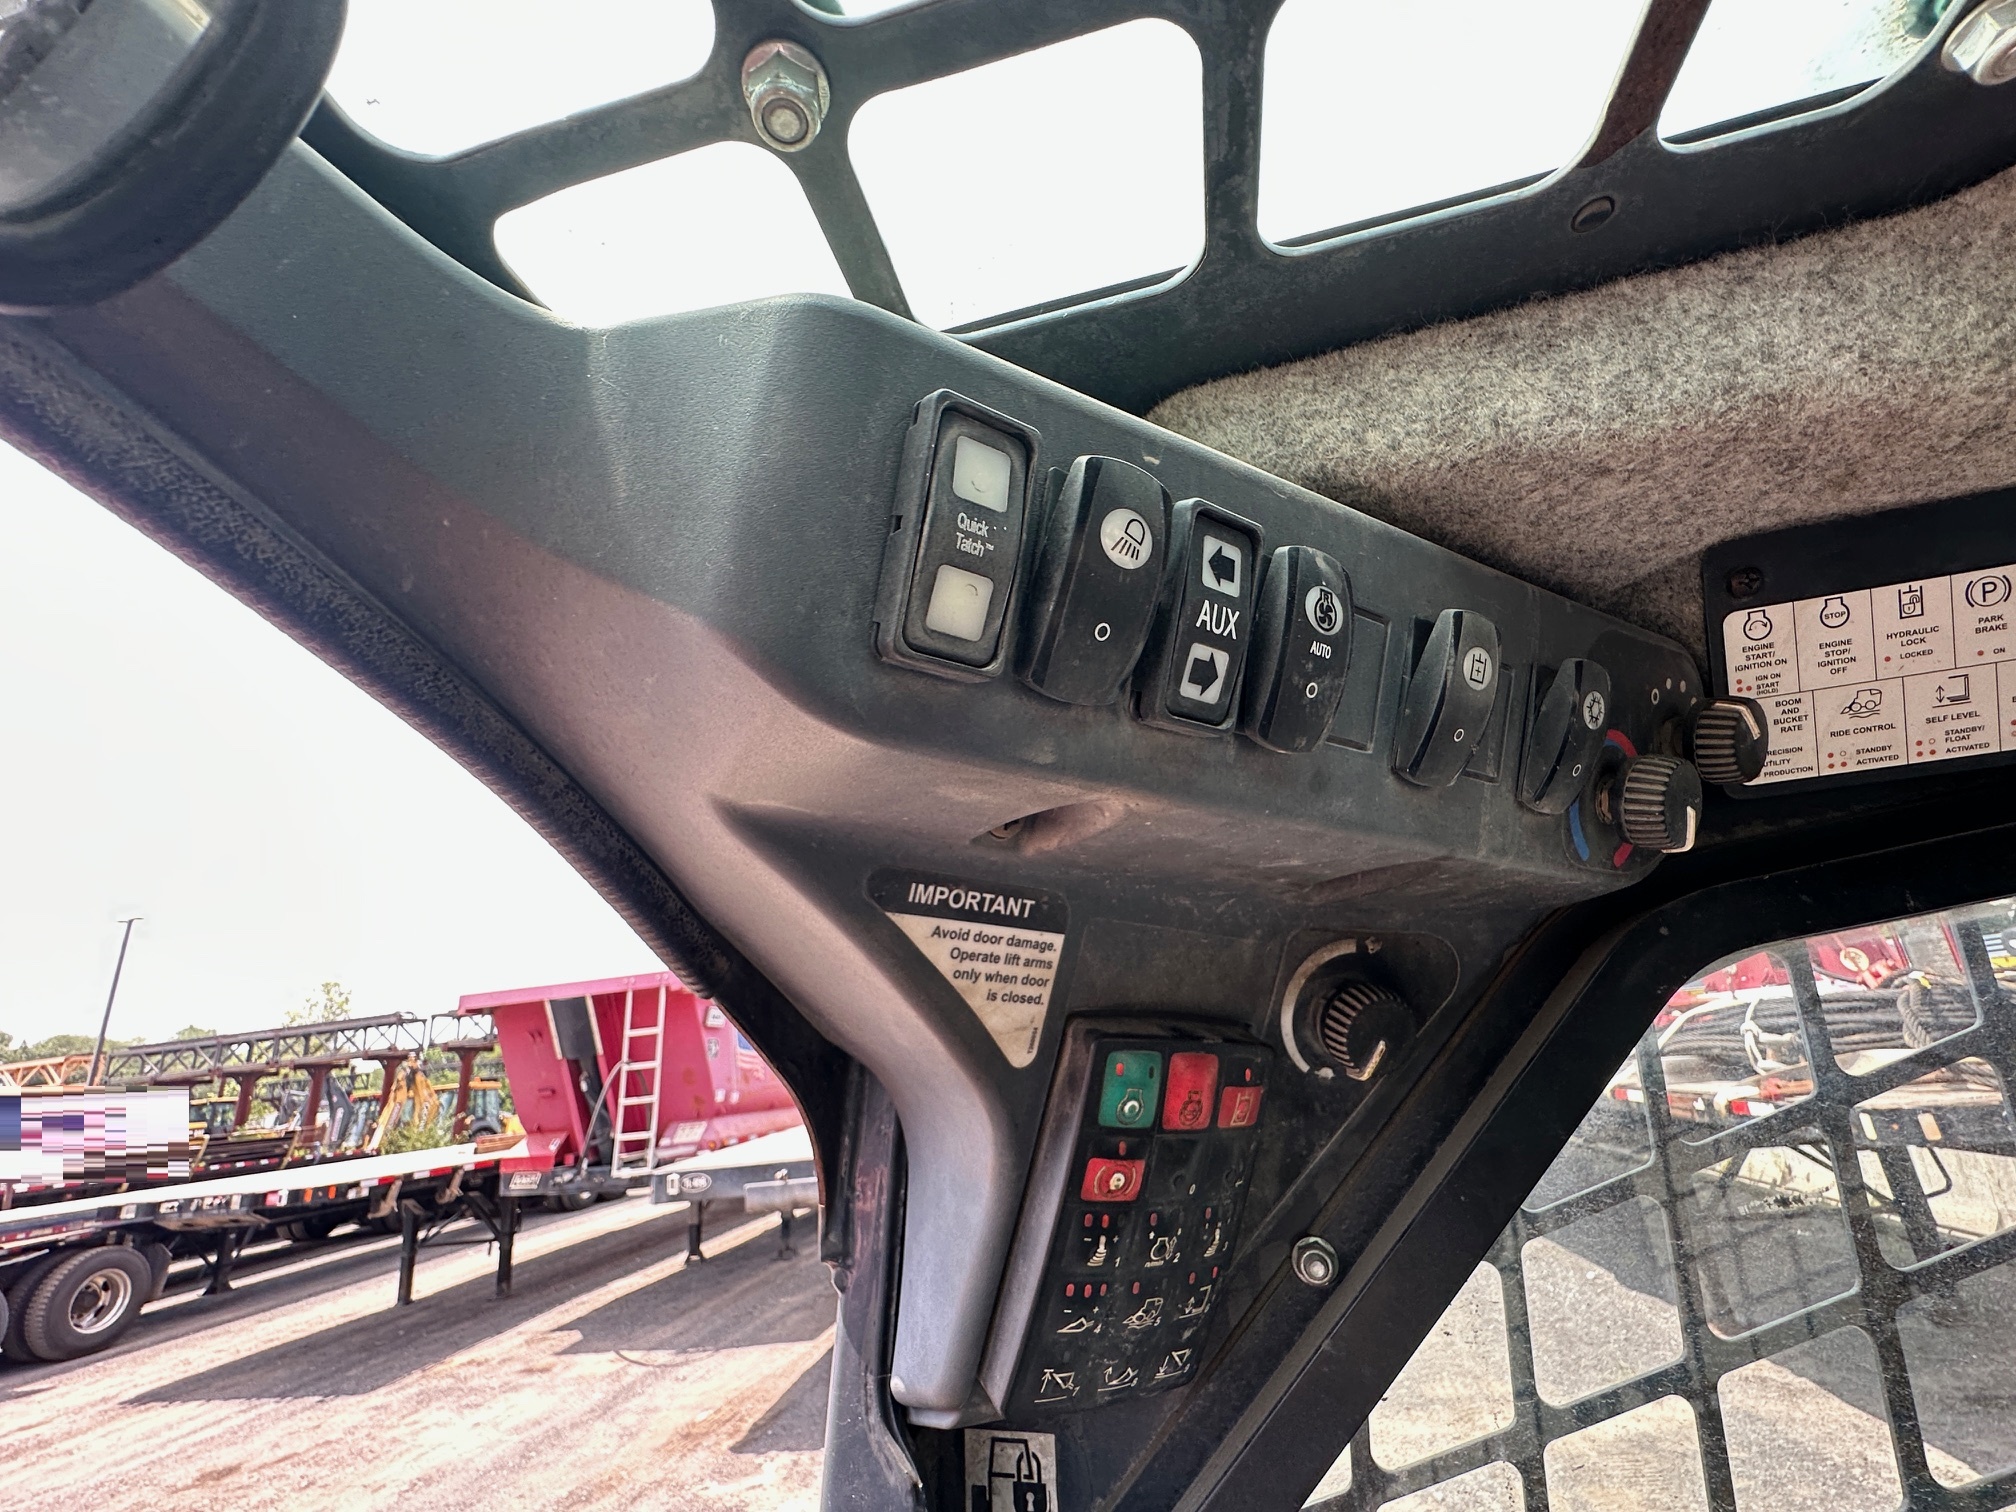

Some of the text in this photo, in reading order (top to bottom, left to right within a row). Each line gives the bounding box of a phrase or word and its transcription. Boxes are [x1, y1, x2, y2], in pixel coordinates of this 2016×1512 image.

[957, 512, 989, 537] Quick
[1196, 600, 1240, 640] AUX
[1824, 611, 1846, 620] STOP
[1978, 614, 2004, 625] PARK
[1886, 625, 1940, 640] HYDRAULIC
[1975, 623, 2008, 634] BRAKE
[1742, 642, 1775, 653] ENGINE
[1819, 639, 1852, 650] ENGINE
[1901, 637, 1926, 647] LOCK
[1310, 641, 1332, 659] AUTO
[1824, 648, 1851, 658] STOP/
[1900, 649, 1934, 659] LOCKED
[1745, 651, 1775, 661] START/
[1735, 658, 1788, 672] IGNITION ON
[1818, 656, 1856, 668] IGNITION
[1830, 666, 1848, 675] OFF
[1756, 681, 1779, 690] START
[1757, 687, 1779, 695] (HOLD)
[1775, 698, 1802, 707] BOOM
[1781, 707, 1800, 715] AND
[1773, 714, 1809, 725] BUCKET
[1925, 710, 1980, 724] SELF LEVEL
[1780, 724, 1803, 733] RATE
[1830, 723, 1896, 738] RIDE CONTROL
[1945, 725, 1985, 736] STANDBY/
[1945, 734, 1971, 743] FLOAT
[1766, 746, 1803, 756] RECISION
[1856, 744, 1892, 755] STANDBY
[1945, 742, 1990, 754] ACTIVATED
[1856, 754, 1900, 766] ACTIVATED
[1764, 766, 1814, 778] PRODUCTION
[908, 882, 1035, 918] IMPORTANT
[931, 925, 1057, 953] Avoid door damage.
[950, 947, 1053, 970] Operate lift arms
[953, 968, 1050, 988] only when door
[986, 989, 1045, 1006] is closed.
[1173, 1252, 1181, 1263] 2
